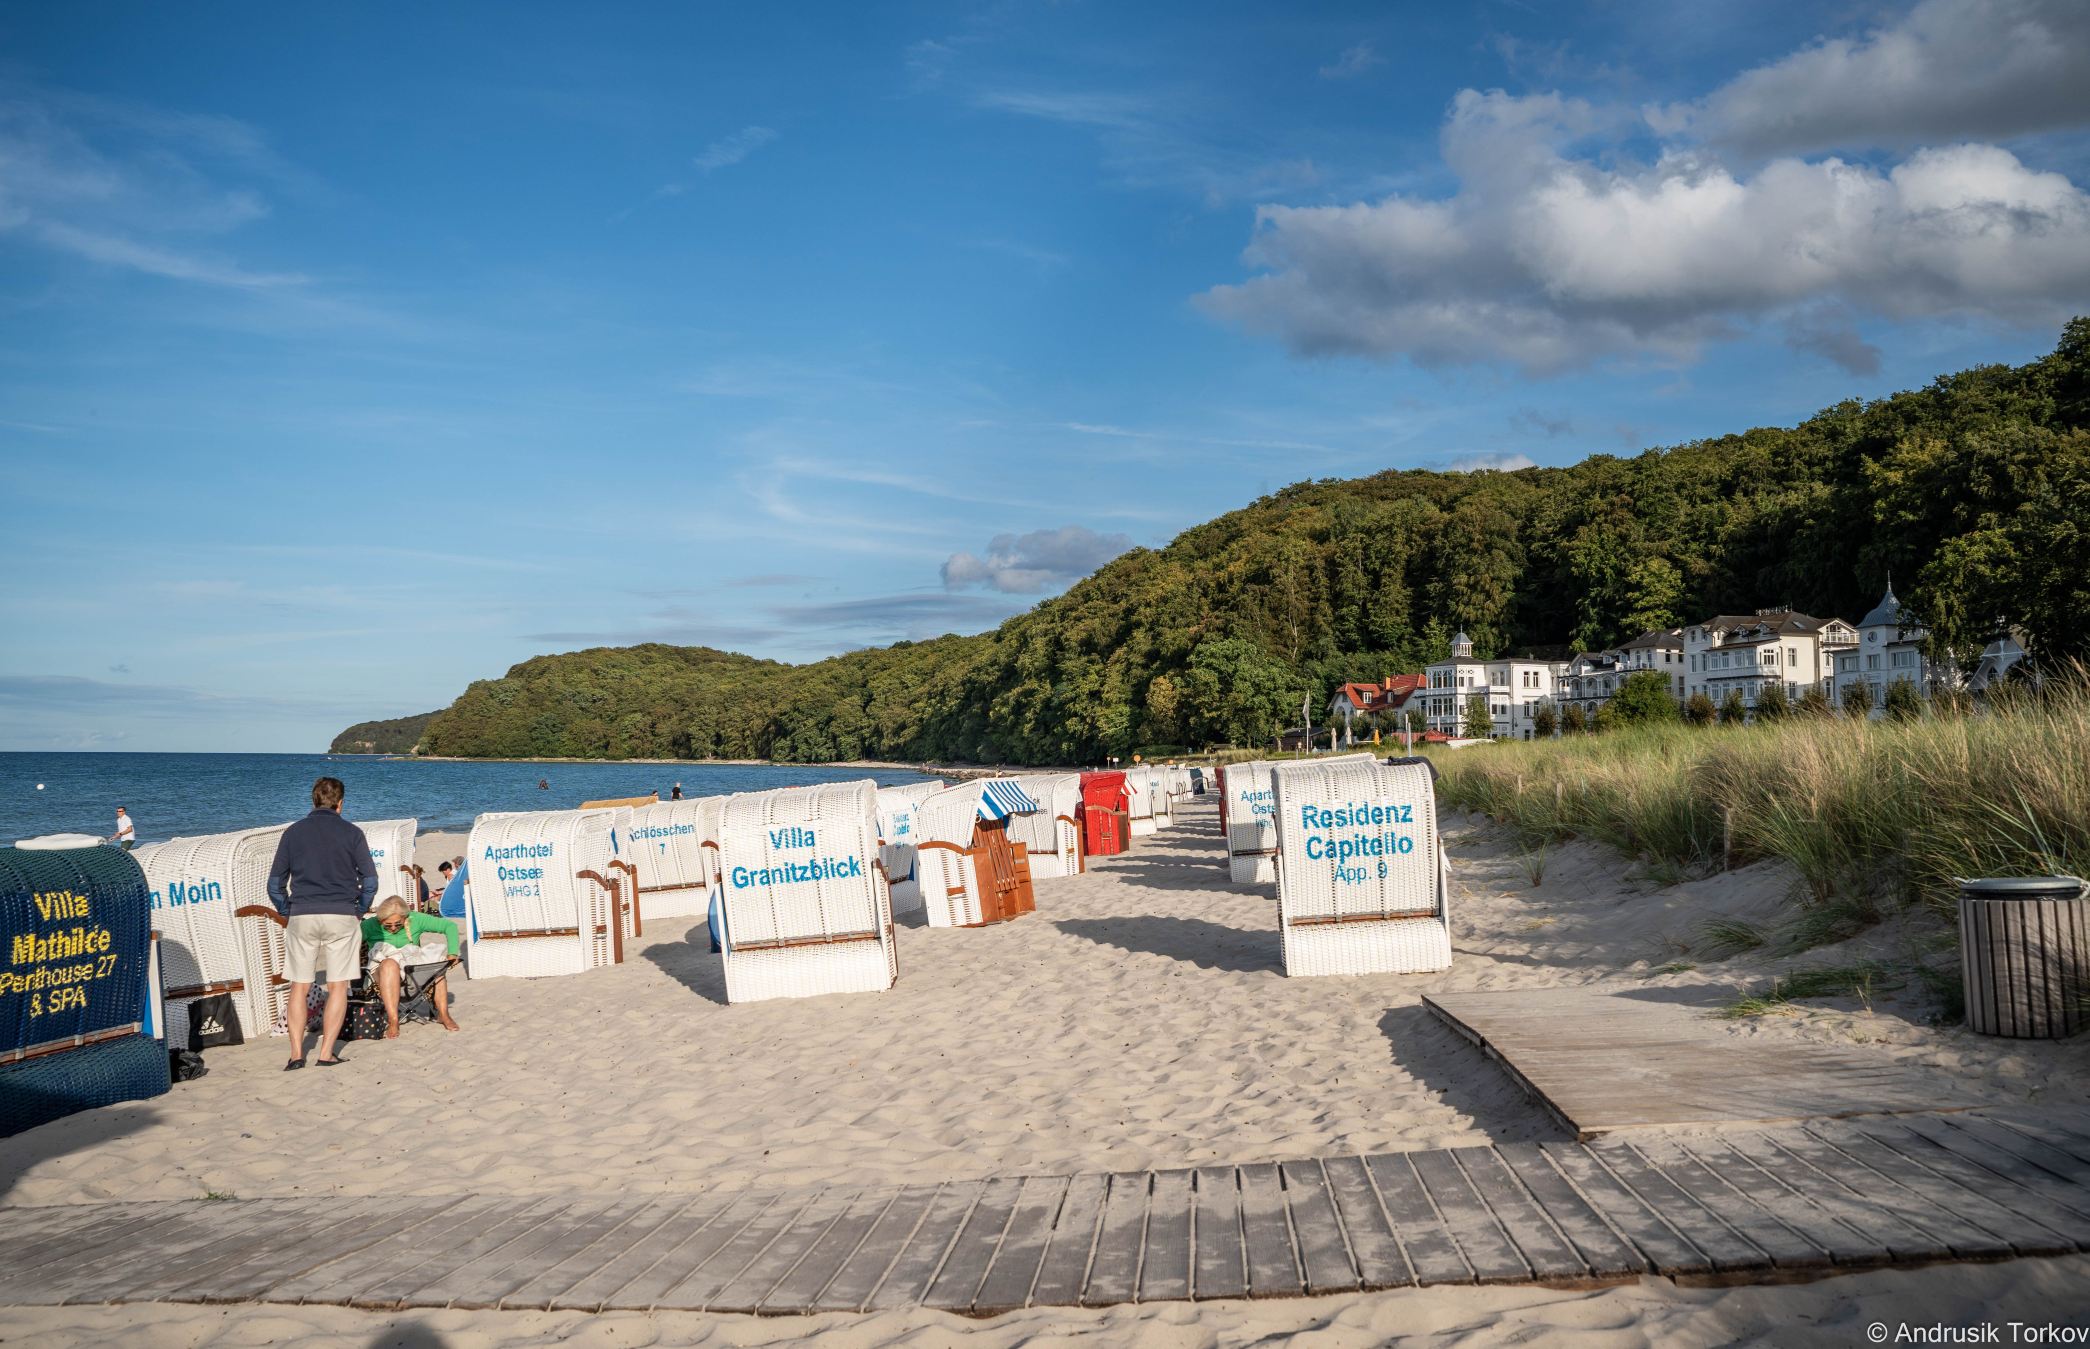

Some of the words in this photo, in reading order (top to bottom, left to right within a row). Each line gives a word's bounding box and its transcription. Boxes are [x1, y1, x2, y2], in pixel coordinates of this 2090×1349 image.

[1301, 801, 1414, 829] Residenz
[484, 842, 554, 863] Aparthotel
[660, 843, 666, 855] 7
[769, 827, 815, 850] Villa
[1306, 831, 1414, 864] Capitello
[498, 866, 543, 881] Ostsee
[731, 855, 861, 889] Granitzblick
[1334, 864, 1372, 885] App.
[1377, 861, 1388, 879] 9
[33, 889, 89, 921] Villa
[168, 876, 222, 907] Moin
[12, 922, 111, 965] Mathilde
[96, 954, 118, 978] 27
[48, 985, 87, 1013] SPA
